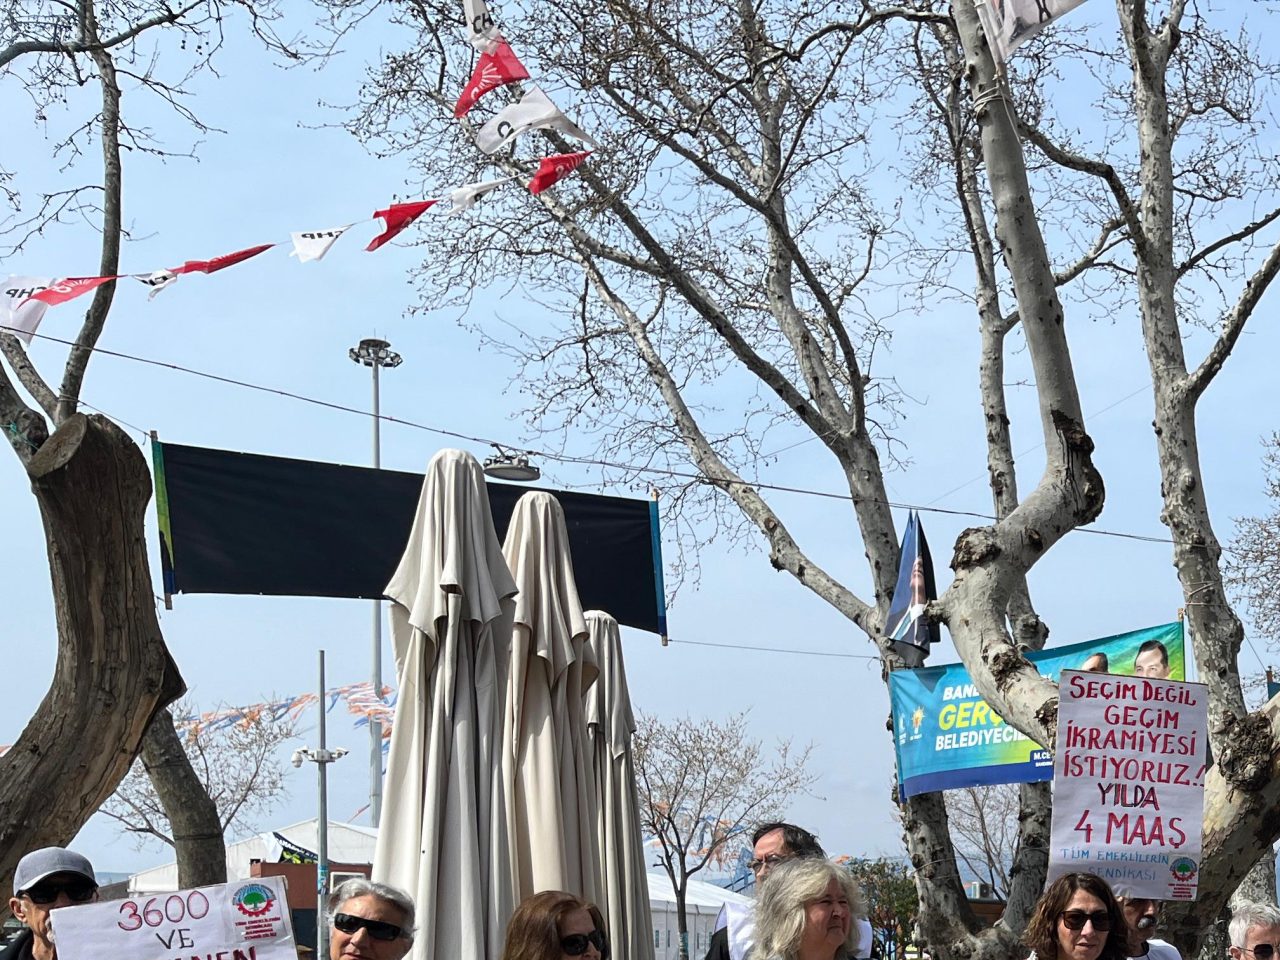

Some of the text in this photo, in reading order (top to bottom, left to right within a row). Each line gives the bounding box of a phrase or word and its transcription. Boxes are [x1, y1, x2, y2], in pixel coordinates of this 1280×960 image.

[1070, 675, 1197, 707] SEÇİM DEĞİL
[1104, 704, 1180, 730] GEÇİM
[1065, 720, 1197, 756] İKRAMİYESİ
[1097, 782, 1160, 811] YILDA
[1073, 809, 1187, 849] 4 MAAŞ
[1061, 847, 1169, 865] TÜM EMEKLİLERİN
[118, 890, 210, 931] 3600
[156, 928, 195, 950] VE
